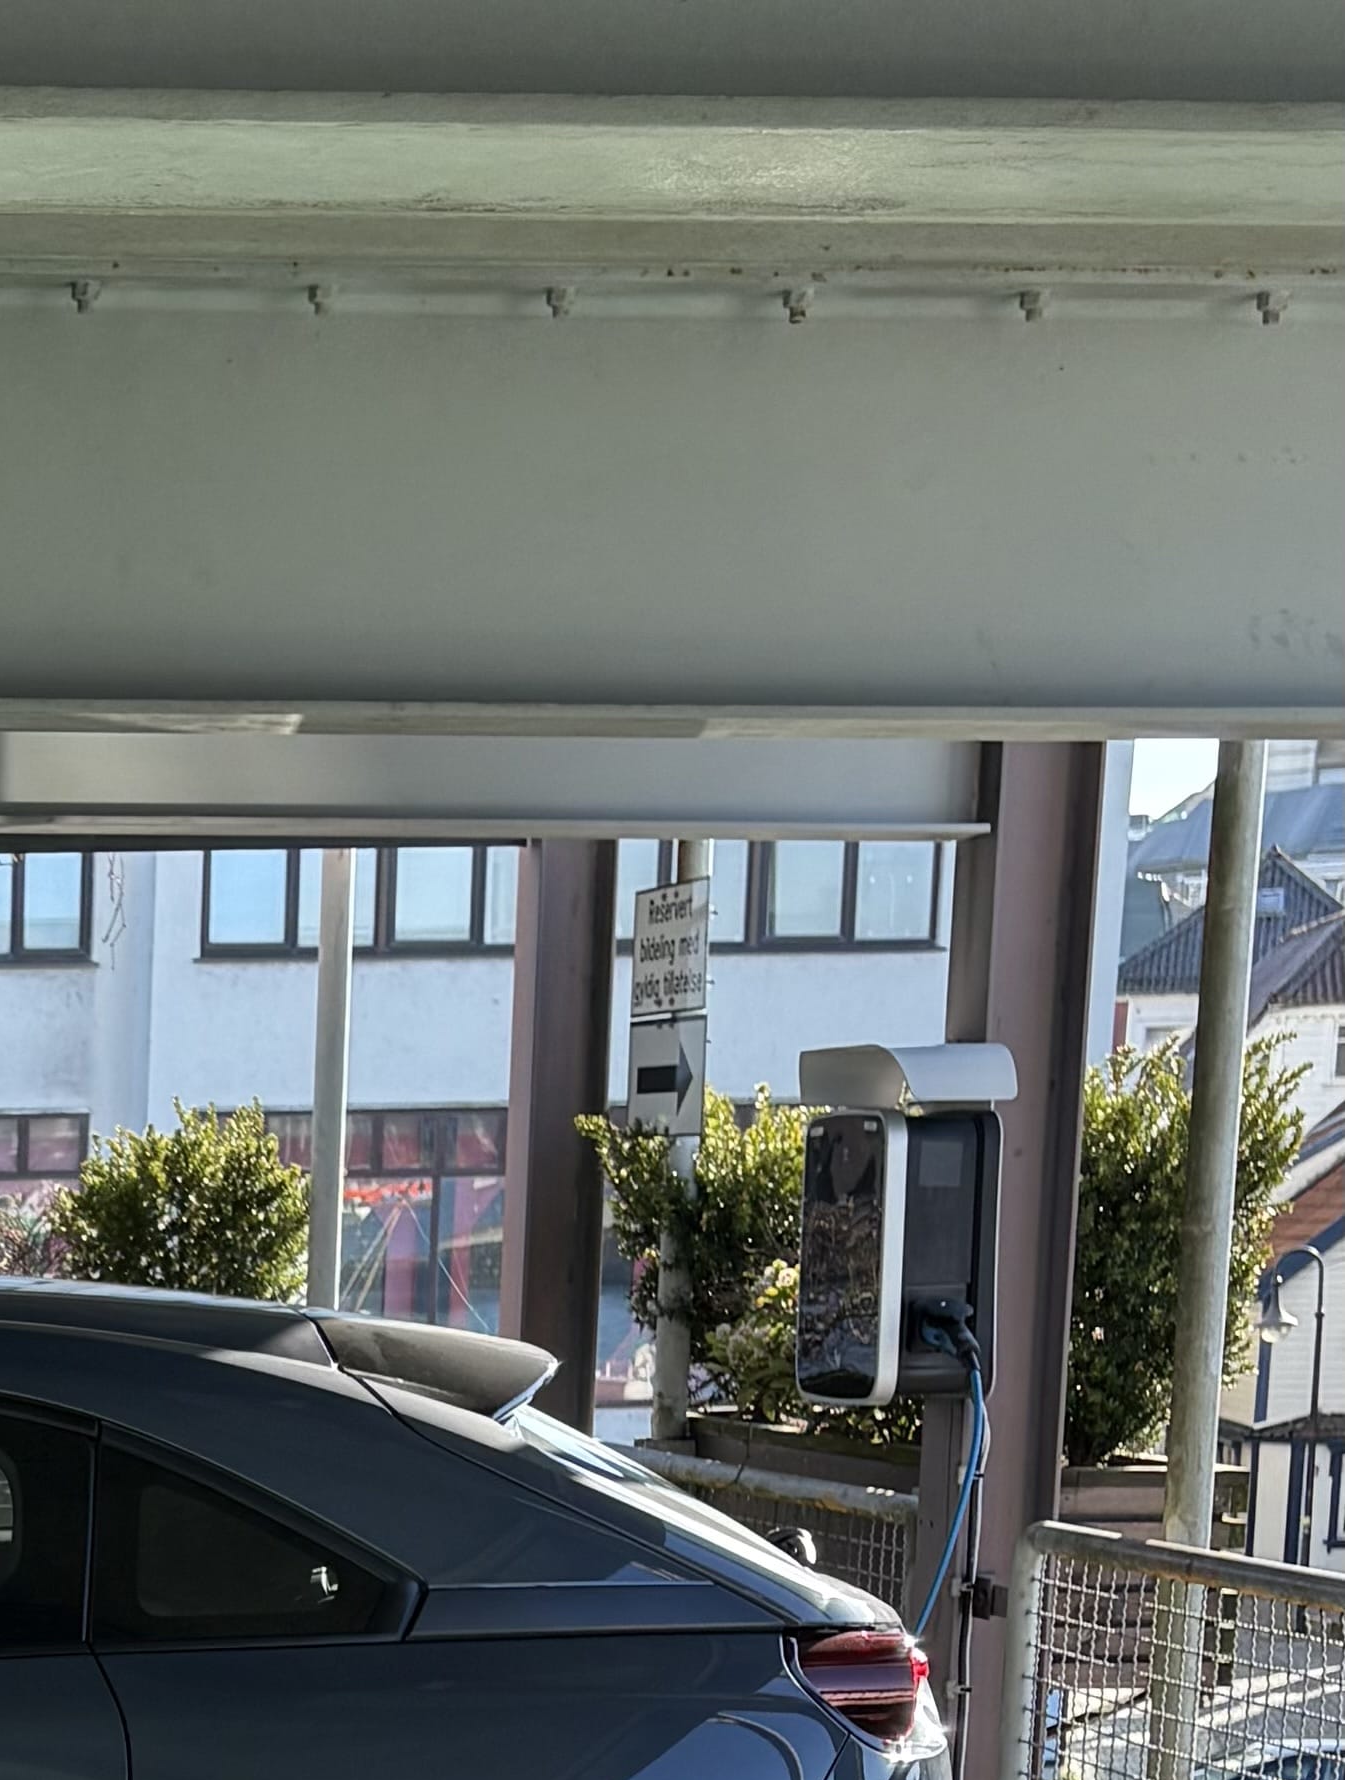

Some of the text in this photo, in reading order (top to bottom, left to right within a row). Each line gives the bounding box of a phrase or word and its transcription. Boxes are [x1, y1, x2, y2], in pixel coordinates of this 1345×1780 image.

[648, 895, 693, 922] Reservert
[640, 929, 701, 965] bildeling med
[633, 967, 702, 1007] gyldig tillatelse
